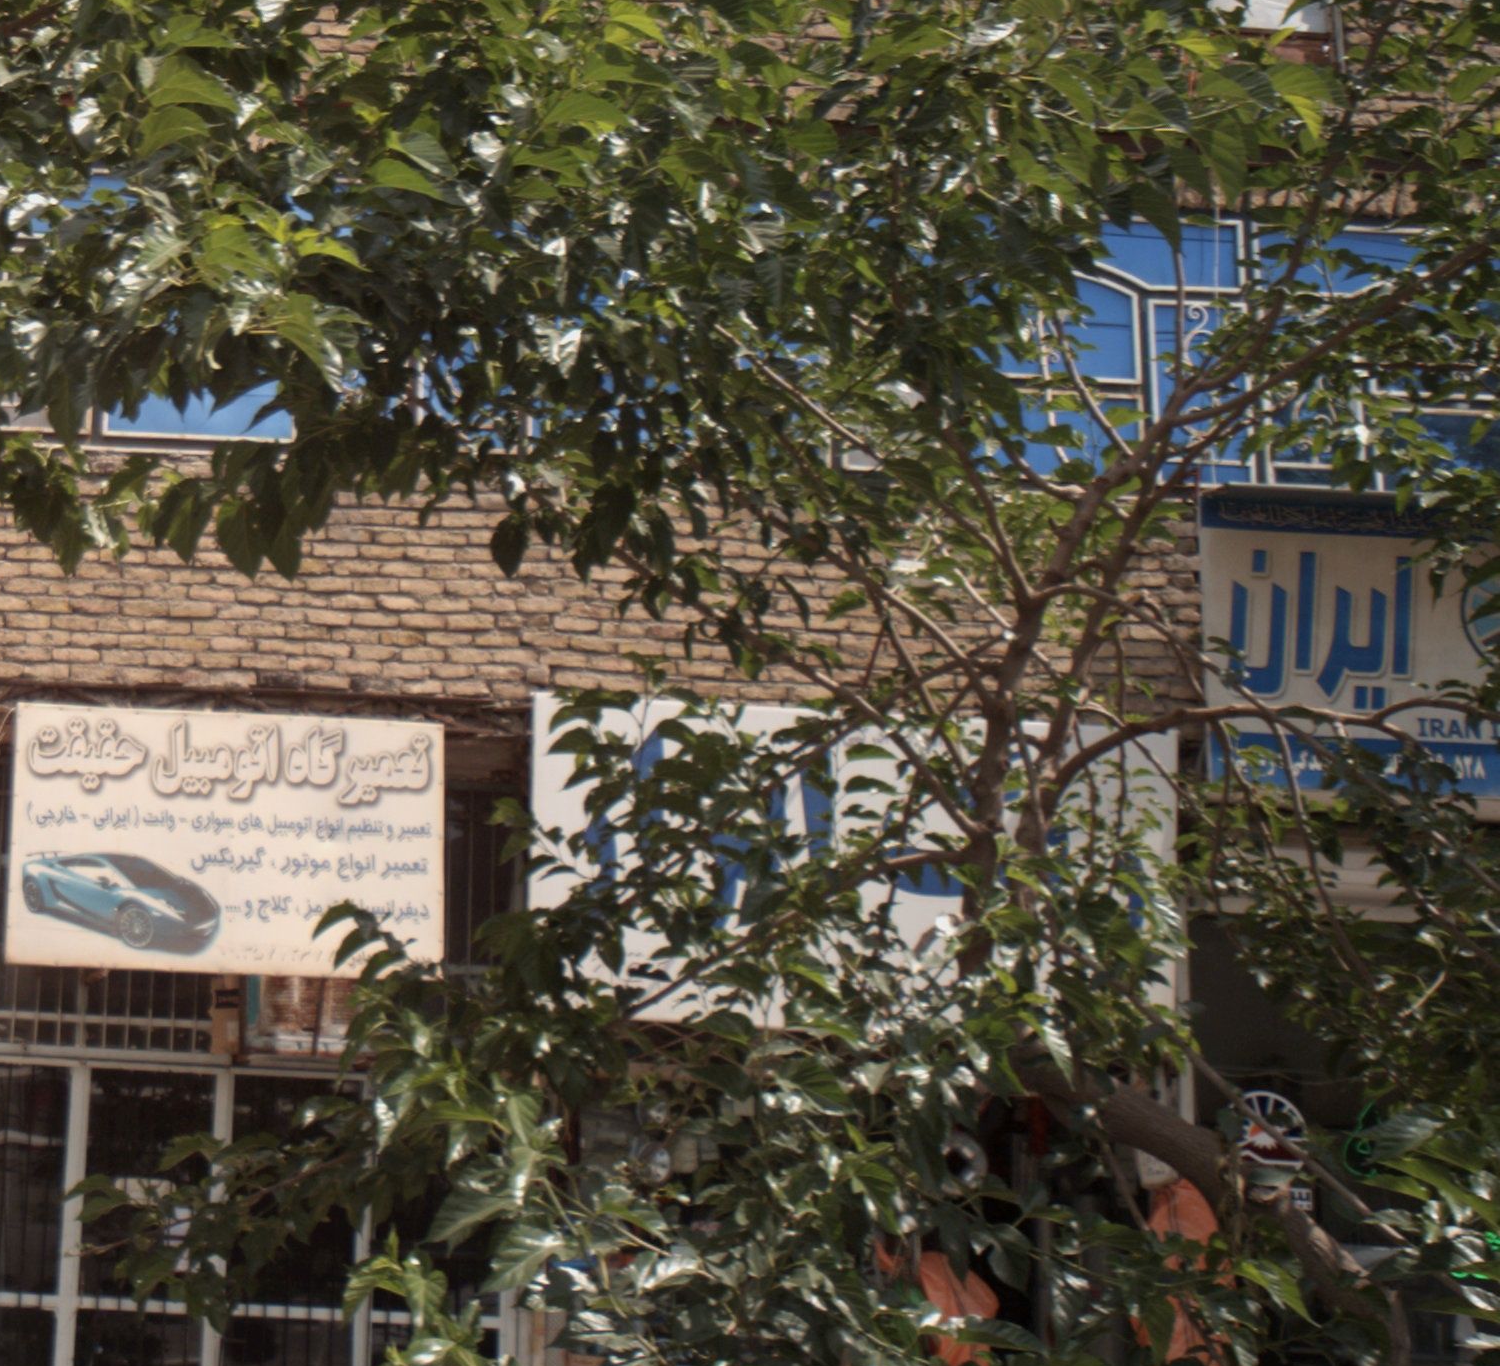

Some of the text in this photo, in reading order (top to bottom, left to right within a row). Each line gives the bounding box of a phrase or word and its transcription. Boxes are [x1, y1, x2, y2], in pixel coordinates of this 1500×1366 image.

[1228, 549, 1413, 709] ایران
[1417, 718, 1481, 740] IRAN
[29, 717, 148, 792] حقیقت
[151, 718, 279, 801] اتومبیل
[190, 846, 267, 874] گیربکس
[337, 853, 375, 880] انواع
[381, 857, 429, 879] تعمیر
